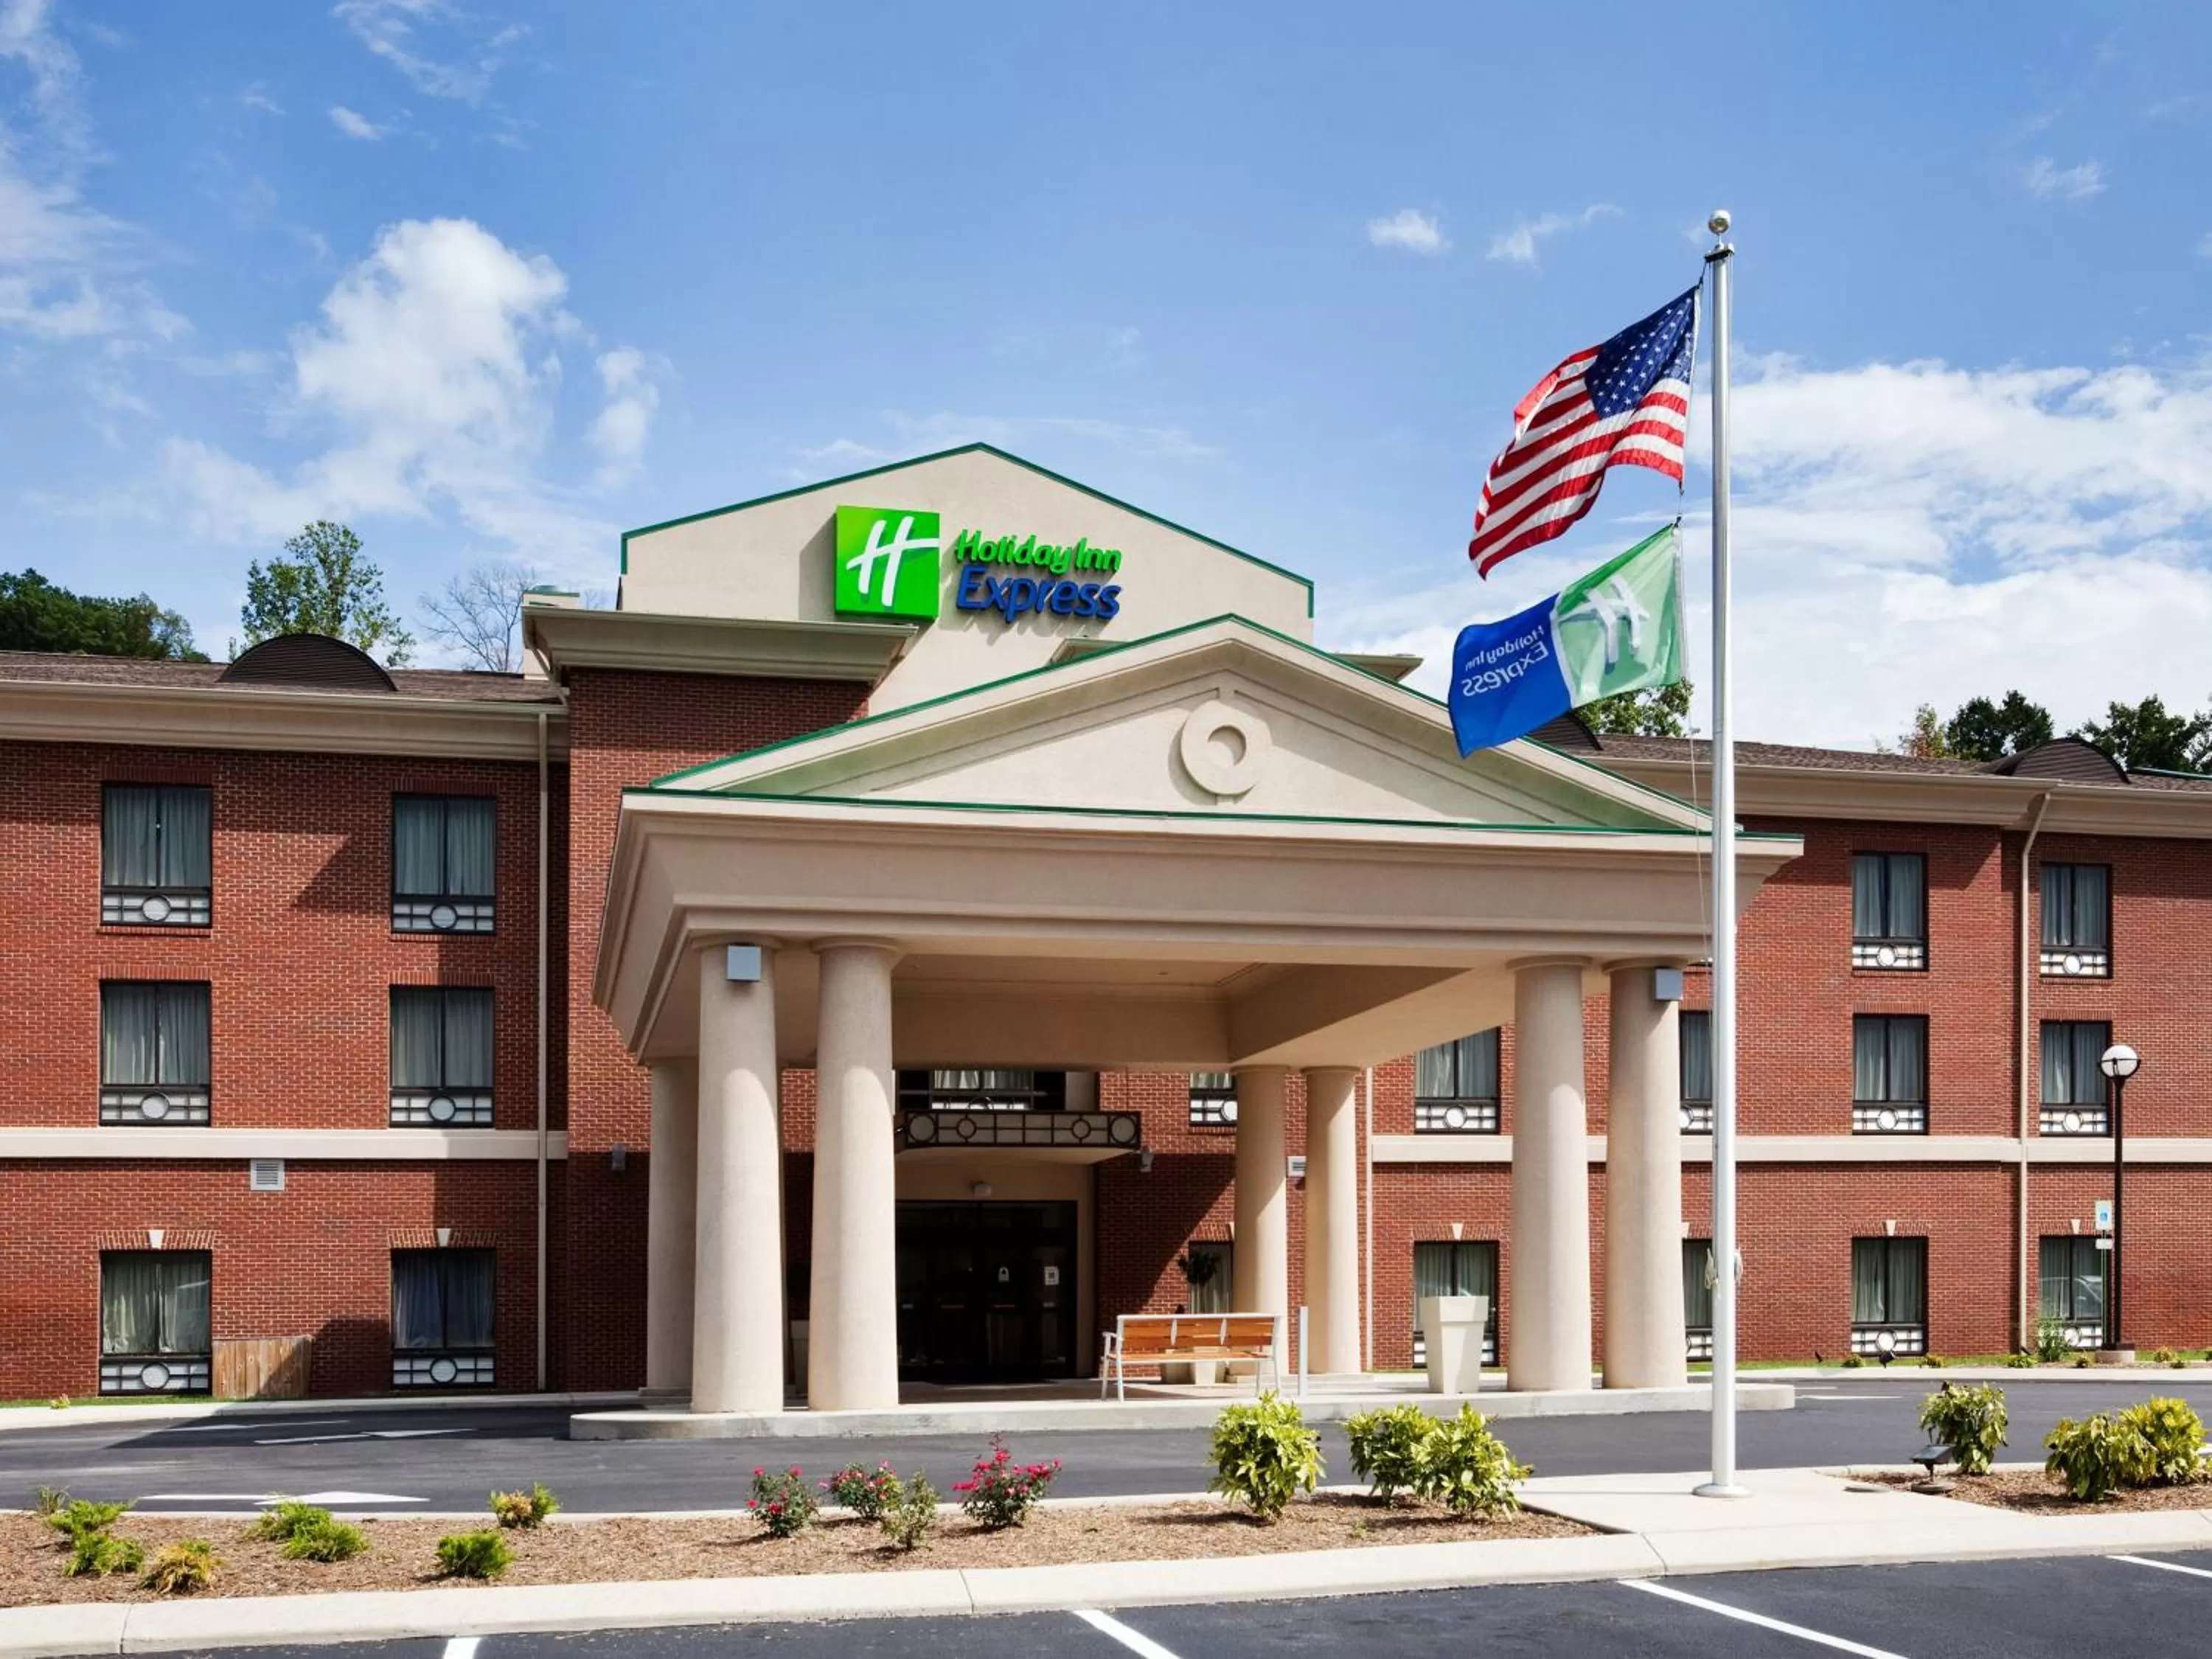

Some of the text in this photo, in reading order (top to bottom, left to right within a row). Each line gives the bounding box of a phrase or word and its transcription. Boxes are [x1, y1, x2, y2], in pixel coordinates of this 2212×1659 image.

[956, 529, 1121, 574] Holiday Inn
[957, 564, 1121, 624] Express
